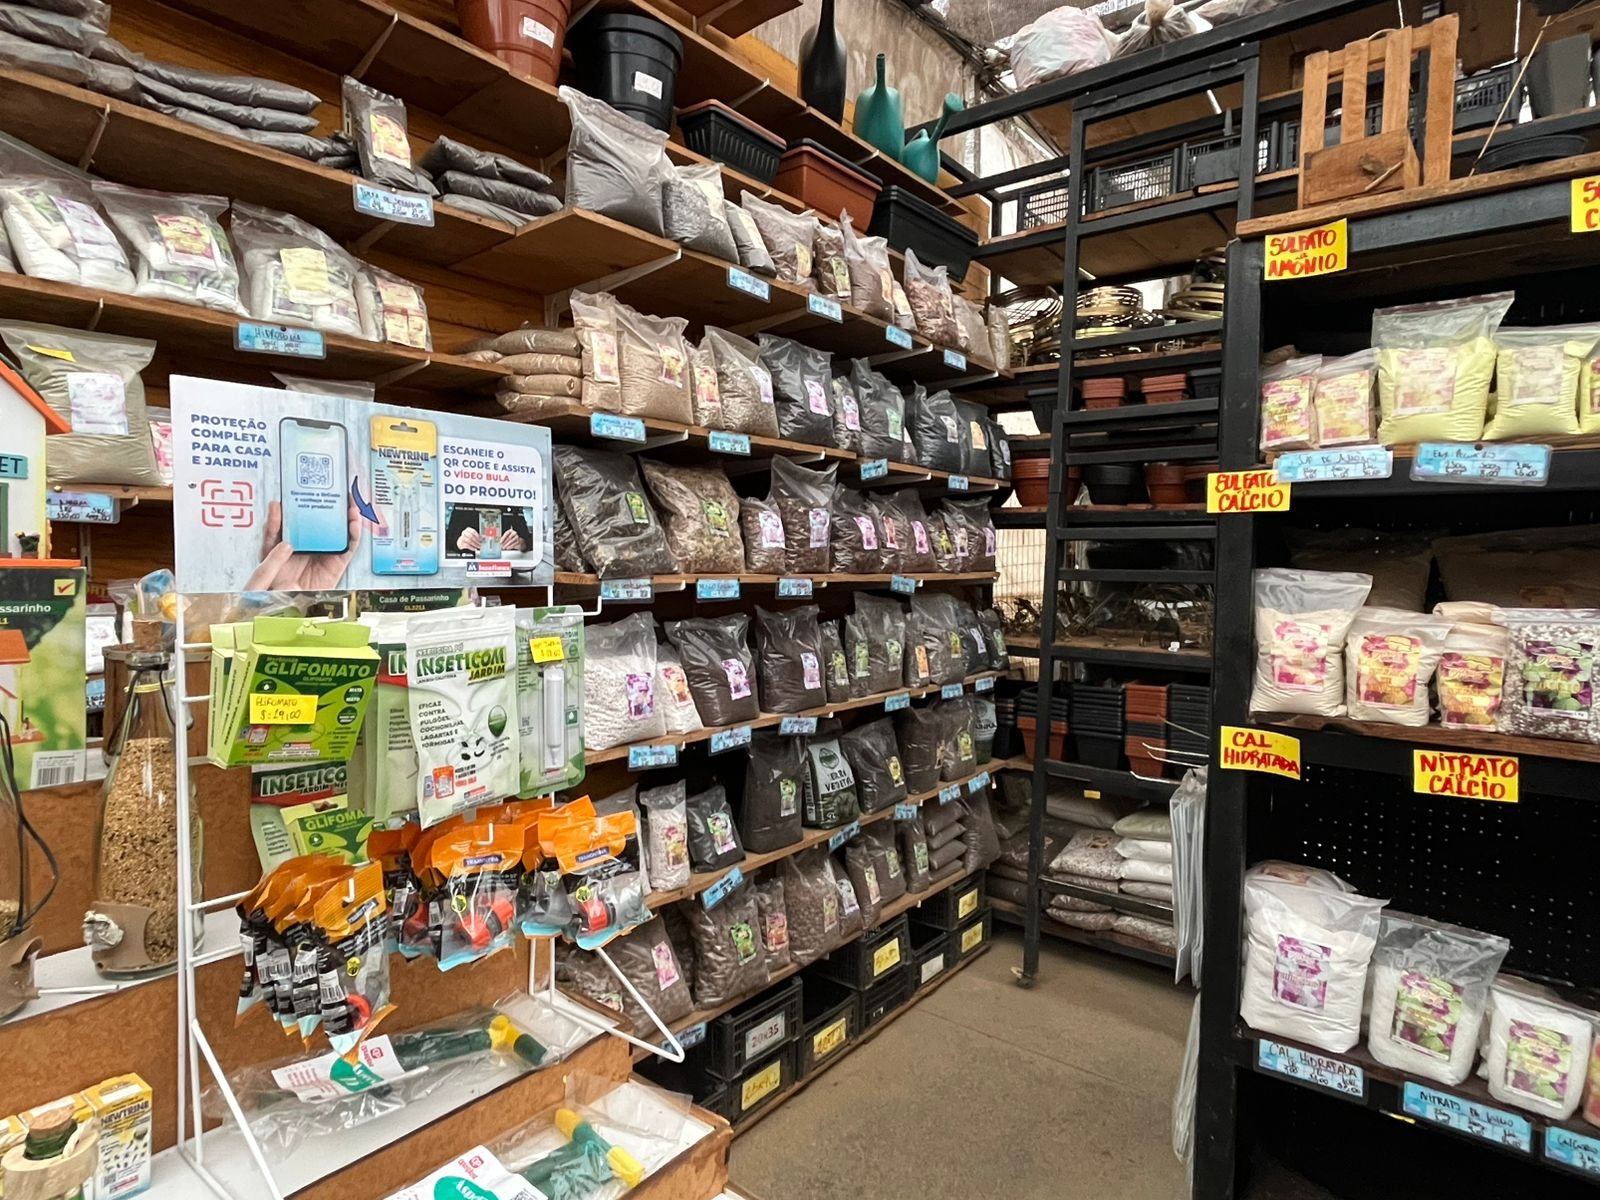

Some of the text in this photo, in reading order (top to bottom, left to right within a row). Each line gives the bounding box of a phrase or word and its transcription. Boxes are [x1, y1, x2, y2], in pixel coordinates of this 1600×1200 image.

[191, 414, 267, 430] PROTEÇÃO
[191, 428, 267, 444] COMPLETA
[192, 442, 272, 457] PARA CASA
[379, 448, 429, 461] NEWTRINE
[443, 445, 505, 459] ESCANEIE O
[192, 455, 258, 469] E JARDIM
[443, 457, 536, 474] QR CODE E ASSISTA
[444, 469, 510, 482] O VÍDEO BULA
[444, 484, 536, 500] DO PRODUTO!
[379, 595, 398, 604] Casa
[411, 594, 450, 603] Passarinho
[264, 661, 371, 677] GLIFOMATO
[469, 664, 505, 680] JARDIM
[418, 701, 442, 710] EFICAZ
[418, 708, 446, 718] CONTRA
[421, 730, 453, 742] LAGARTAS
[422, 738, 455, 749] FORMIGAS
[1232, 731, 1272, 748] CAL
[1223, 747, 1300, 775] HIDRATADA
[305, 808, 365, 831] GLIFOMA
[101, 1101, 150, 1125] NEWTRINE
